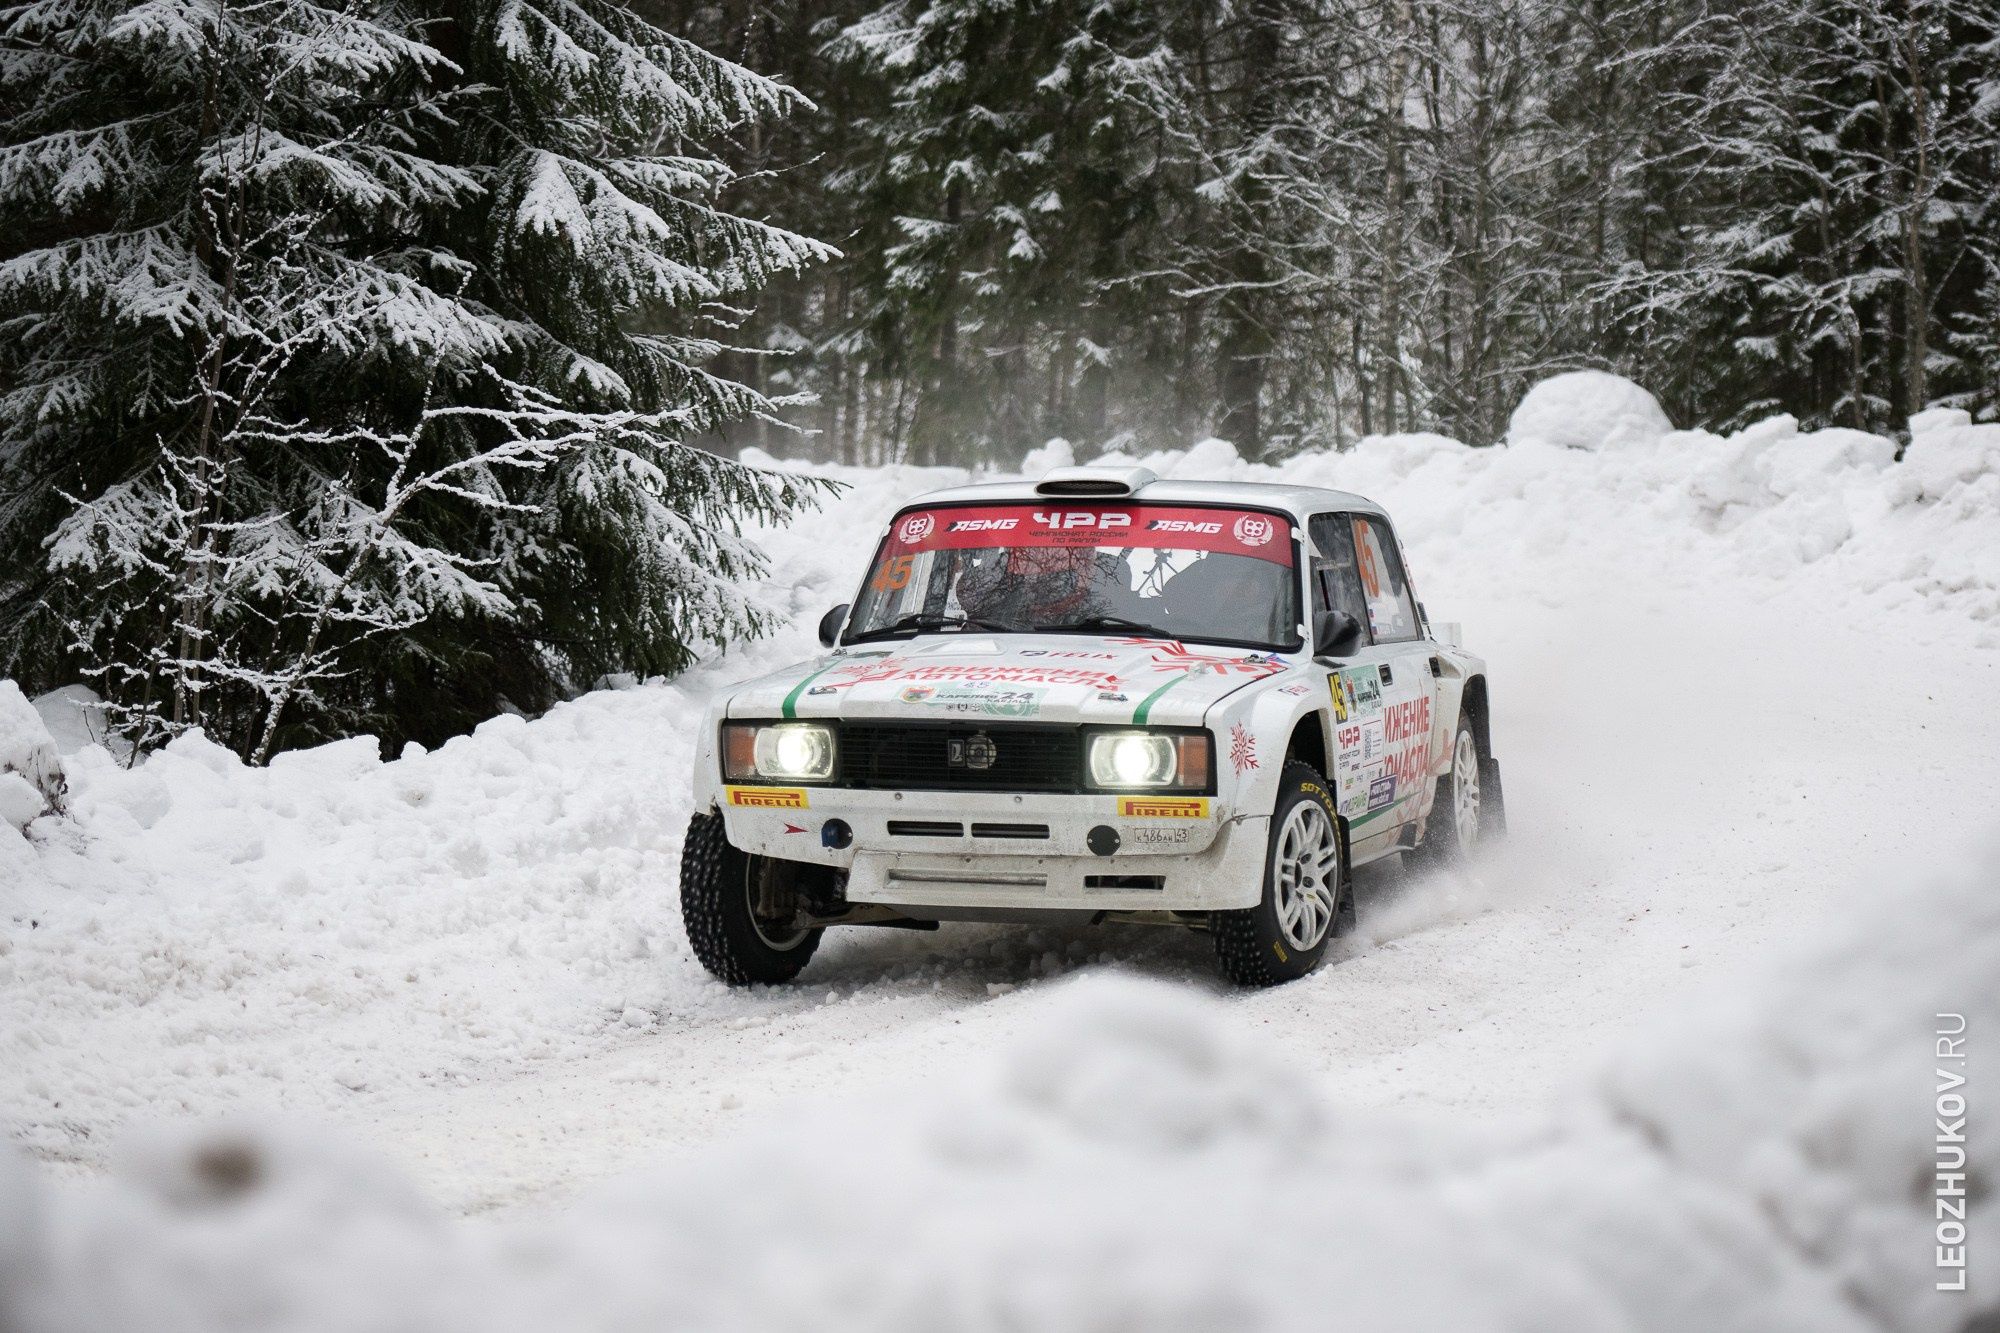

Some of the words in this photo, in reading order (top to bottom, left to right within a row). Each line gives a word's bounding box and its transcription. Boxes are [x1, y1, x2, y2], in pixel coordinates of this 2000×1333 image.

[949, 518, 1020, 533] ASMG
[1032, 512, 1132, 530] ЧРР
[1151, 519, 1224, 534] ASMG
[1029, 530, 1087, 538] ЧЕМПИОНАТ
[1353, 519, 1380, 598] 45
[869, 554, 915, 593] 45
[1048, 650, 1120, 660] FELIX
[892, 672, 1119, 692] АВТОМАСЛА
[964, 681, 991, 689] 45
[1329, 674, 1347, 721] 45
[1384, 695, 1430, 743] ИЖЕНИЕ
[1338, 726, 1360, 749] ЧРР
[1384, 743, 1429, 785] ОМАСЛА
[733, 790, 802, 808] PIRELLI
[1125, 801, 1202, 817] PIRELLI
